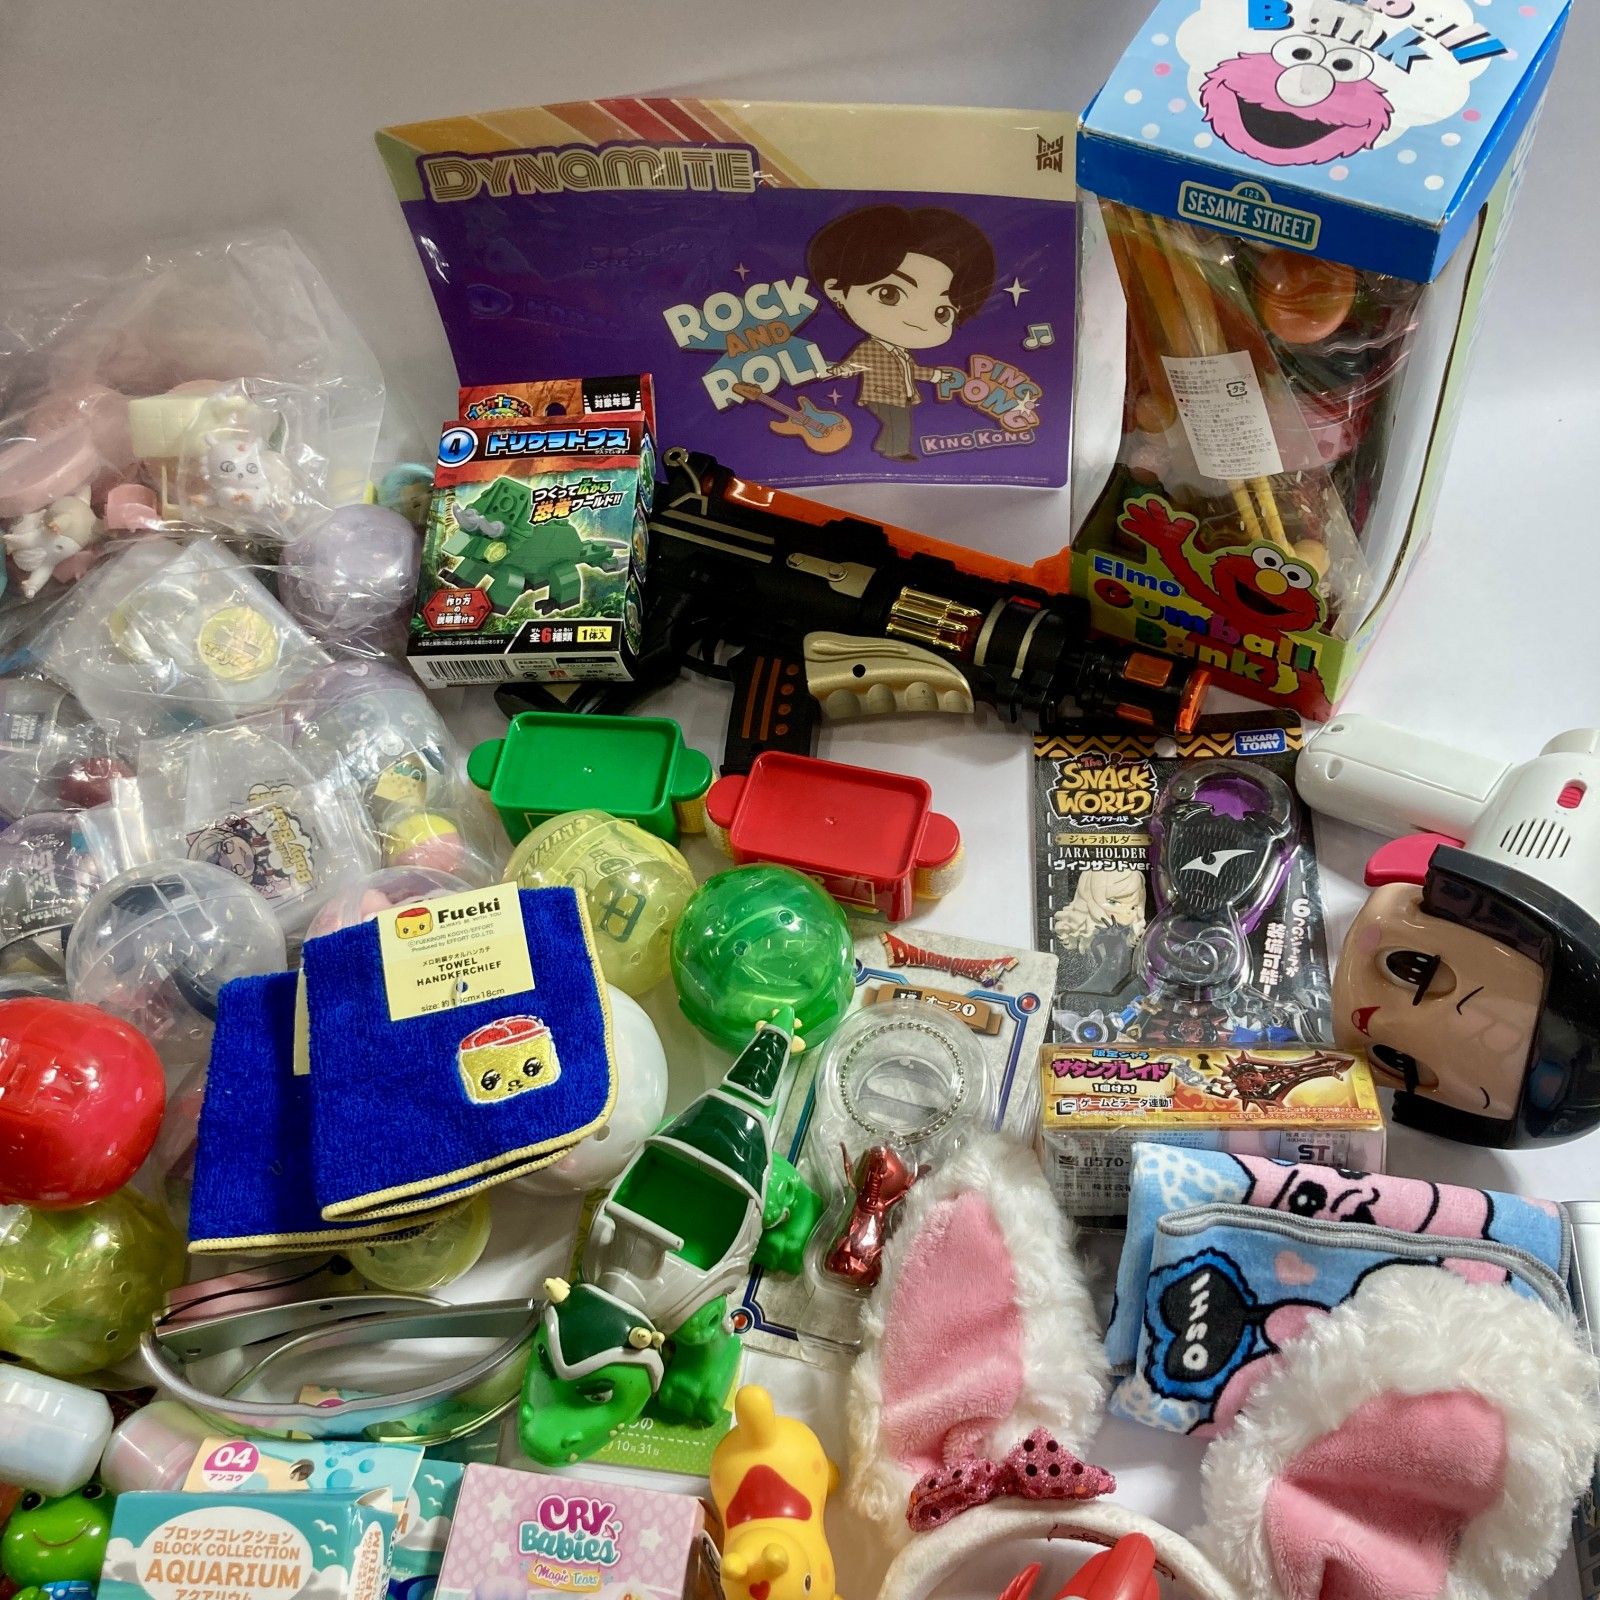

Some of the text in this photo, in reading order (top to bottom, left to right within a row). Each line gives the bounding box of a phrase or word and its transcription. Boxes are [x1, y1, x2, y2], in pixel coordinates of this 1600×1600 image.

[1248, 0, 1433, 74] Bank
[1036, 152, 1063, 173] TAN
[1244, 188, 1260, 200] 123
[1187, 190, 1312, 240] SESAME STREET
[663, 276, 819, 348] ROCK
[726, 321, 791, 358] AND
[702, 344, 828, 410] ROLL
[971, 356, 1041, 401] PING
[594, 397, 631, 410] 対象年齢
[939, 371, 1038, 430] PONG
[447, 438, 461, 458] 4
[488, 430, 630, 452] トリケラトプス
[924, 430, 1031, 452] KING KONG
[534, 482, 610, 501] つくって広がる
[1093, 556, 1181, 598] Elmo
[446, 596, 472, 607] 作り方
[453, 605, 461, 613] の
[529, 626, 574, 644] 全6種類
[581, 629, 608, 641] 1体入
[1094, 578, 1318, 673] Gumball
[1135, 617, 1263, 682] Bank
[1240, 733, 1280, 742] TAKARA
[1241, 740, 1280, 751] TOMY
[1081, 757, 1102, 767] The
[1062, 762, 1152, 790] SNACK
[1056, 790, 1152, 815] WORLD
[1080, 815, 1129, 823] スナックワールド
[1069, 835, 1142, 845] ジャラホルダー
[1059, 847, 1147, 859] JARA HOLDER
[437, 897, 501, 924] Fueki
[446, 934, 469, 944] EFFORT
[438, 957, 478, 972] TOWEL
[421, 1004, 439, 1012] size:
[1093, 1049, 1149, 1059] 限定ジャラ
[1051, 1058, 1172, 1082] サタンブレイド
[1093, 1083, 1137, 1094] 1個付き!
[1080, 1098, 1173, 1109] ゲームとデータ連動!
[1298, 1144, 1330, 1161] ST
[1183, 1272, 1210, 1370] OSHI
[214, 1446, 253, 1468] 04
[208, 1472, 244, 1482] アンコウ
[540, 1497, 613, 1536] CRY
[164, 1526, 294, 1544] ブロックコレクション
[521, 1523, 619, 1564] Babies
[153, 1541, 300, 1560] BLOCK COLLECTION
[144, 1558, 302, 1589] AQUARIUM
[534, 1564, 597, 1585] Magic Tears
